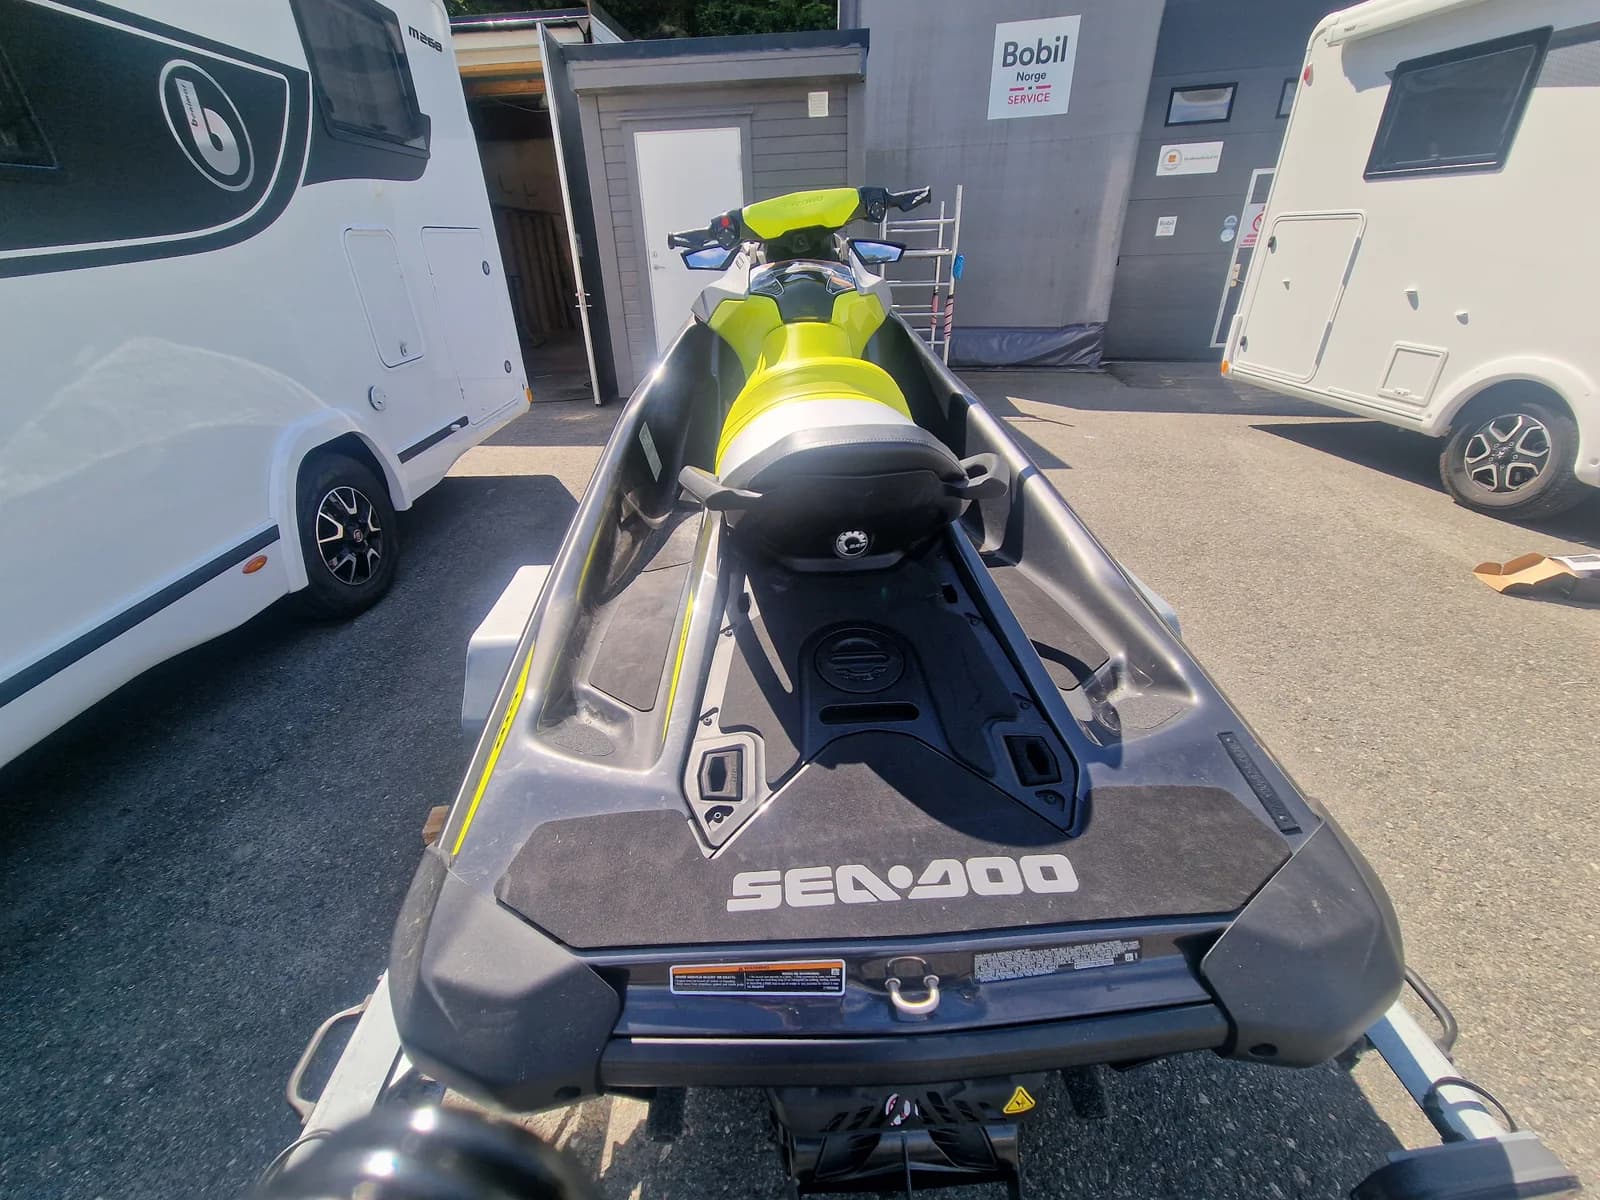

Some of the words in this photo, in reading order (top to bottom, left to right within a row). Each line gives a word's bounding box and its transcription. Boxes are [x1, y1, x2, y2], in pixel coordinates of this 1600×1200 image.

[1002, 35, 1069, 68] Bobil
[1016, 71, 1047, 83] Norge
[1007, 92, 1051, 105] SERVICE
